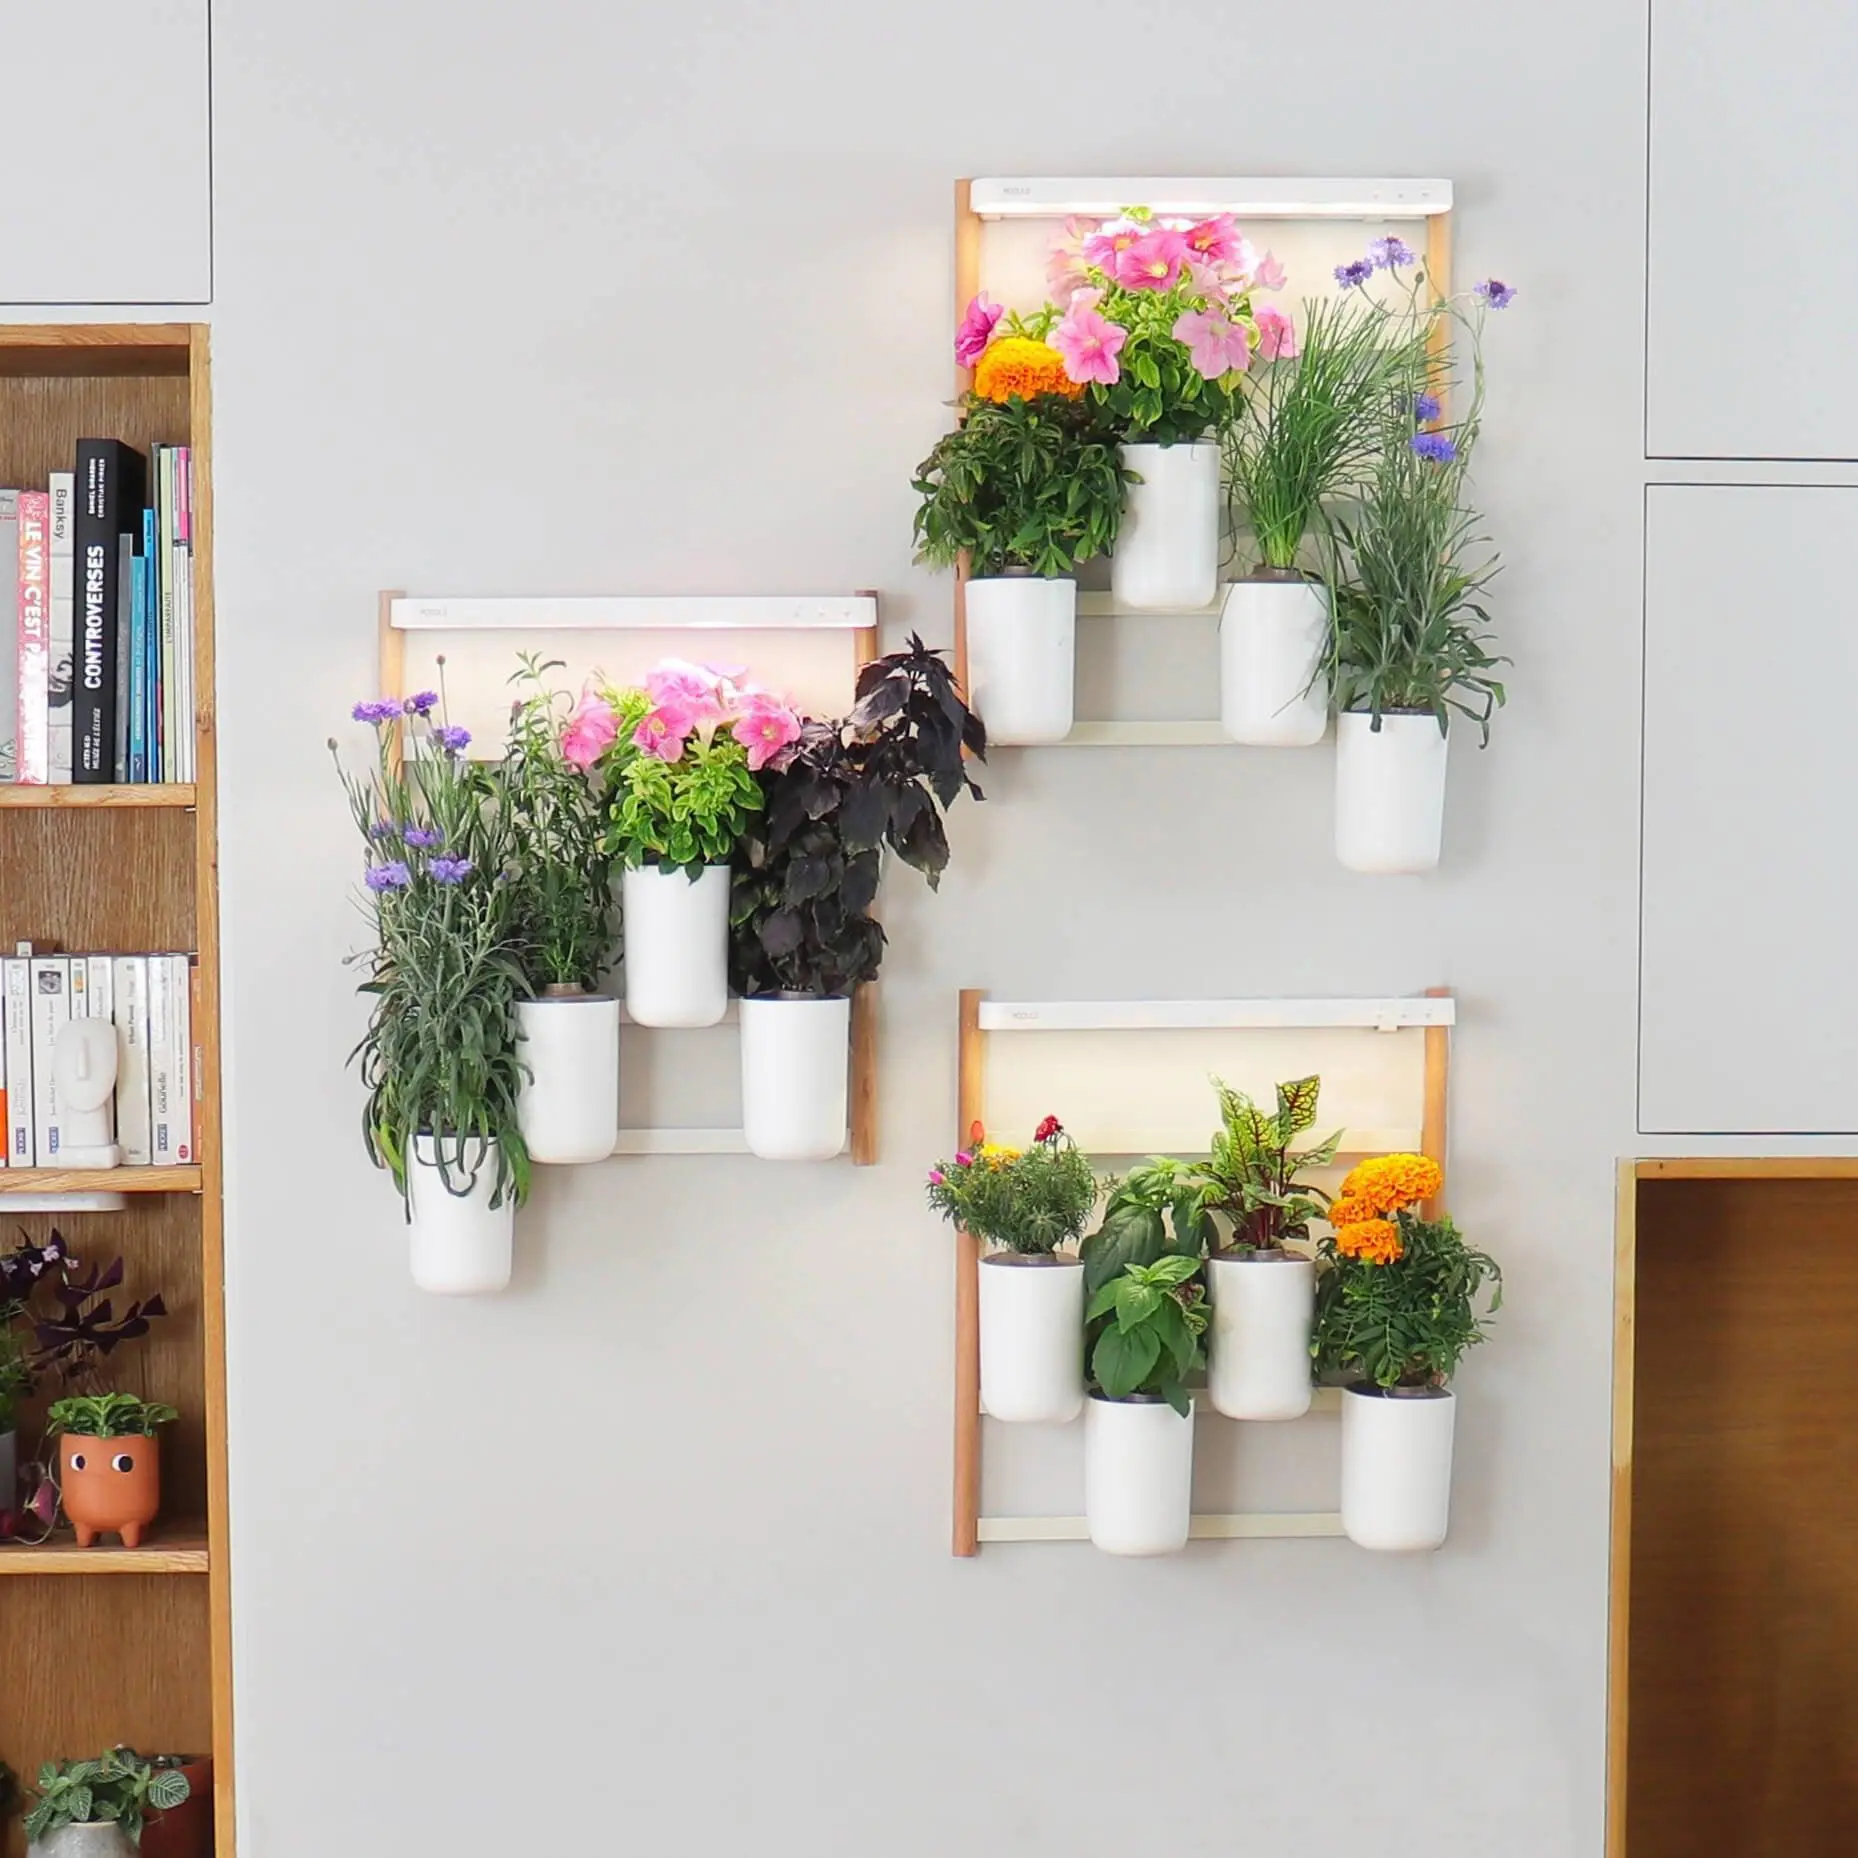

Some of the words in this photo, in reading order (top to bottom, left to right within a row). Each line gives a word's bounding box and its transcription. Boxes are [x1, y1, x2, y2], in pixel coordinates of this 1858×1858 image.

[25, 521, 42, 541] LE
[54, 489, 67, 540] Banksy
[25, 546, 42, 580] VIN
[24, 586, 41, 638] C'EST
[84, 545, 104, 689] CONTROVERSES
